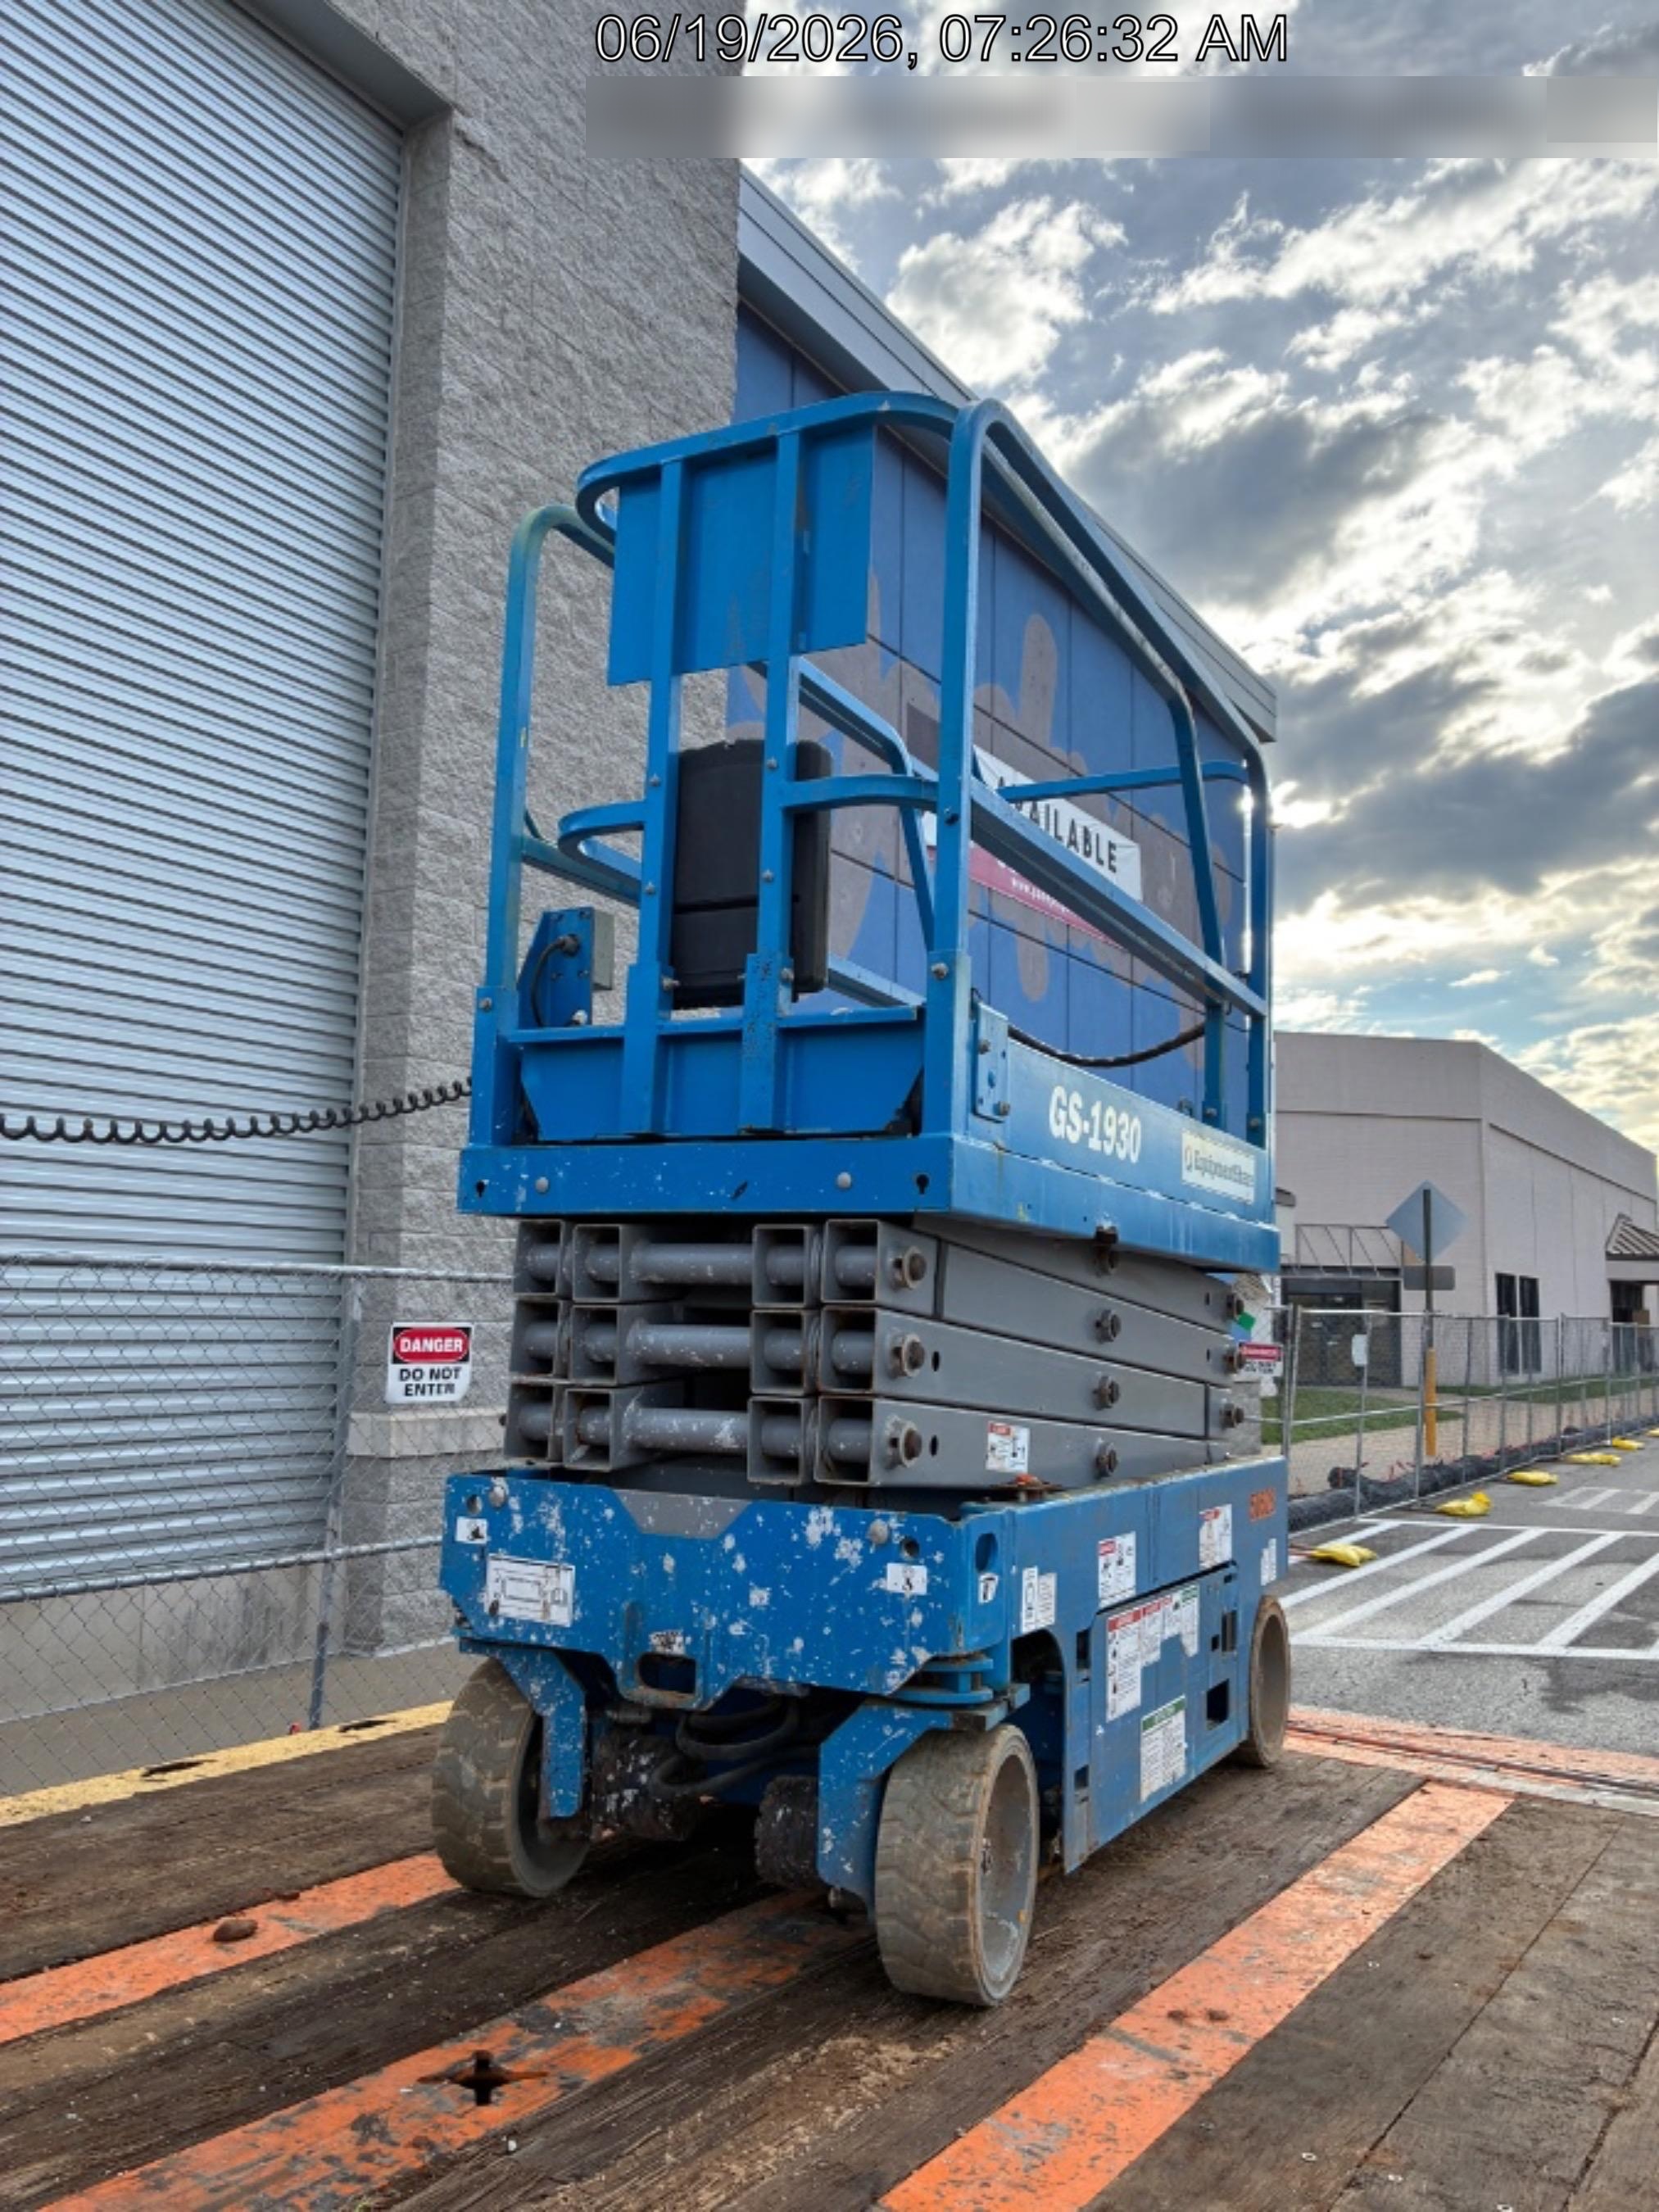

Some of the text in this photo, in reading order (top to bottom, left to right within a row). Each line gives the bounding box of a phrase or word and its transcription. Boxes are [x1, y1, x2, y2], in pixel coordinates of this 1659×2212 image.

[997, 776, 1117, 874] AILABLE
[1049, 1085, 1142, 1163] GS-1930
[399, 1336, 464, 1353] DANGER
[399, 1367, 462, 1382] DO NOT
